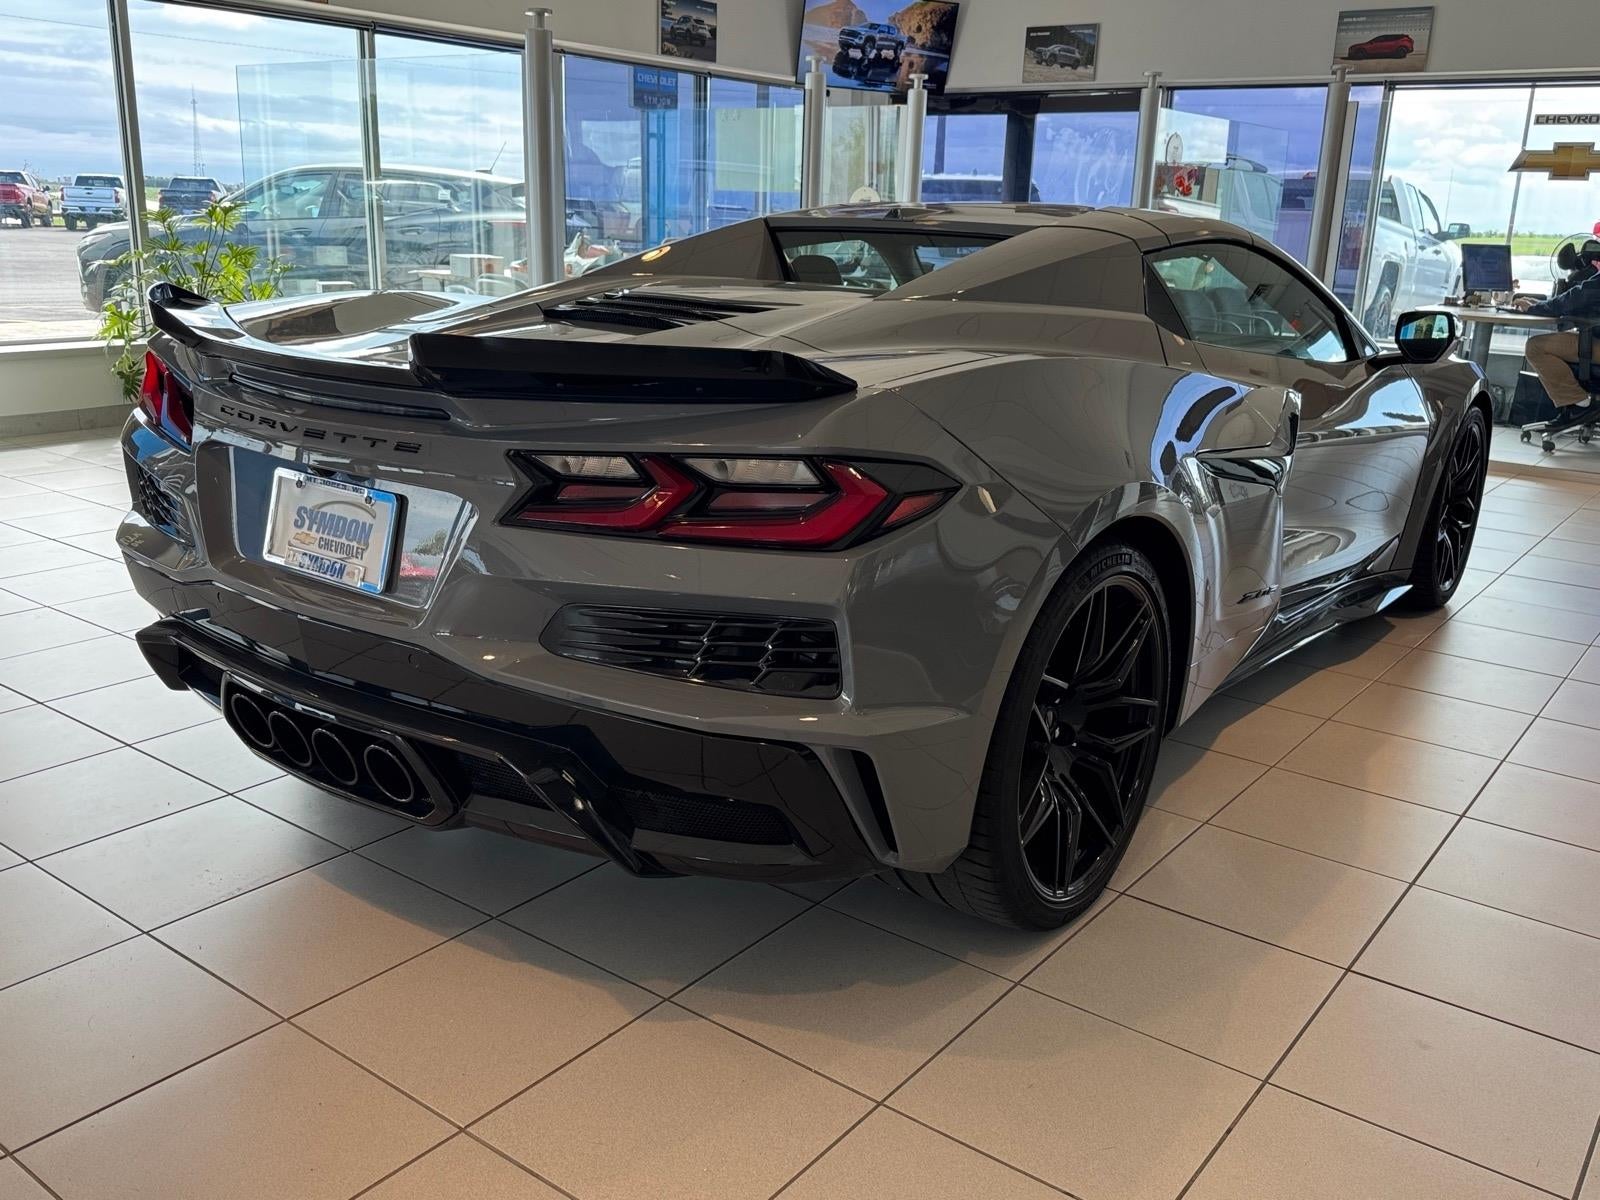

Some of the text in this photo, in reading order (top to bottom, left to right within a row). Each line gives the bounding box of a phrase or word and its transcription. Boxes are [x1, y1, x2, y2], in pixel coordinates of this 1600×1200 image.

[1536, 114, 1600, 125] CHEVRO
[220, 404, 422, 454] CORVETTE
[293, 505, 374, 545] SYMDON
[317, 536, 366, 561] CHEVROLET
[299, 552, 347, 579] SYMDON
[1090, 553, 1131, 578] MICHELIN
